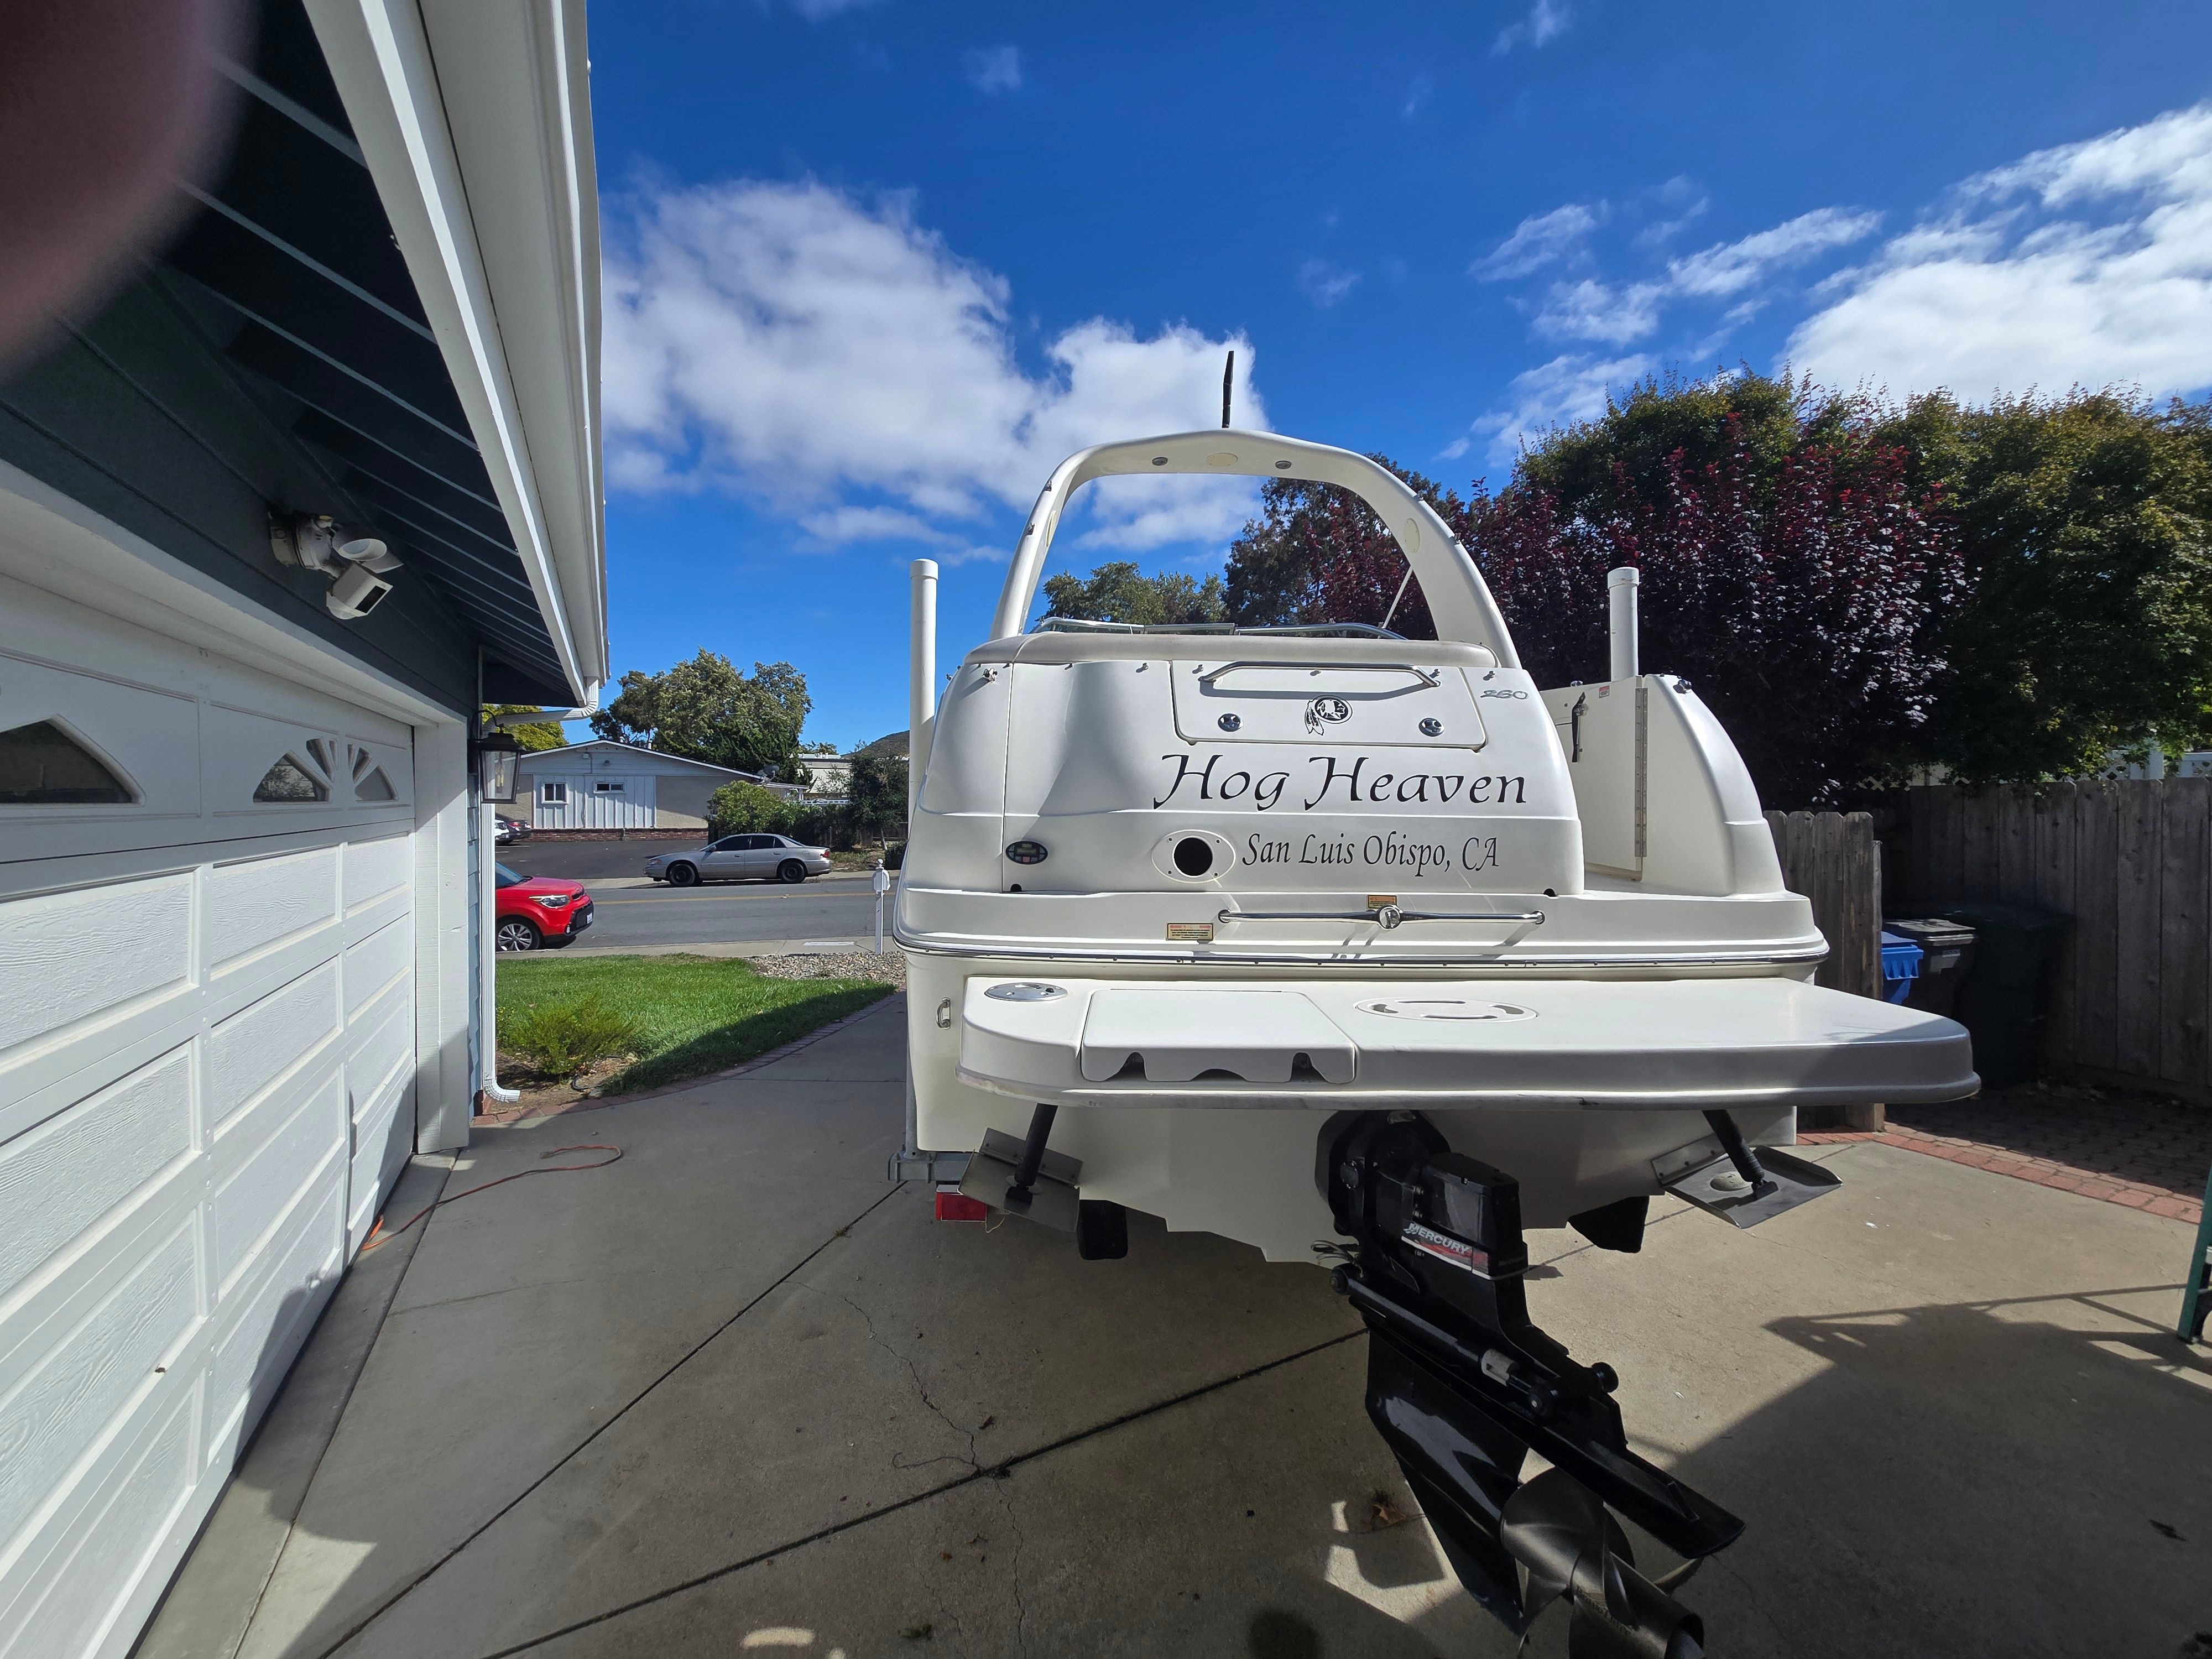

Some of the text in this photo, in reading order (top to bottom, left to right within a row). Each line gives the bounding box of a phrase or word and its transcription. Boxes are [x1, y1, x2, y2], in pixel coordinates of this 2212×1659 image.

[1480, 690, 1530, 700] 260
[1153, 754, 1526, 811] Hog Heaven
[1242, 831, 1499, 878] San Luis Obispo, CA
[1405, 1223, 1469, 1254] MERCURY
